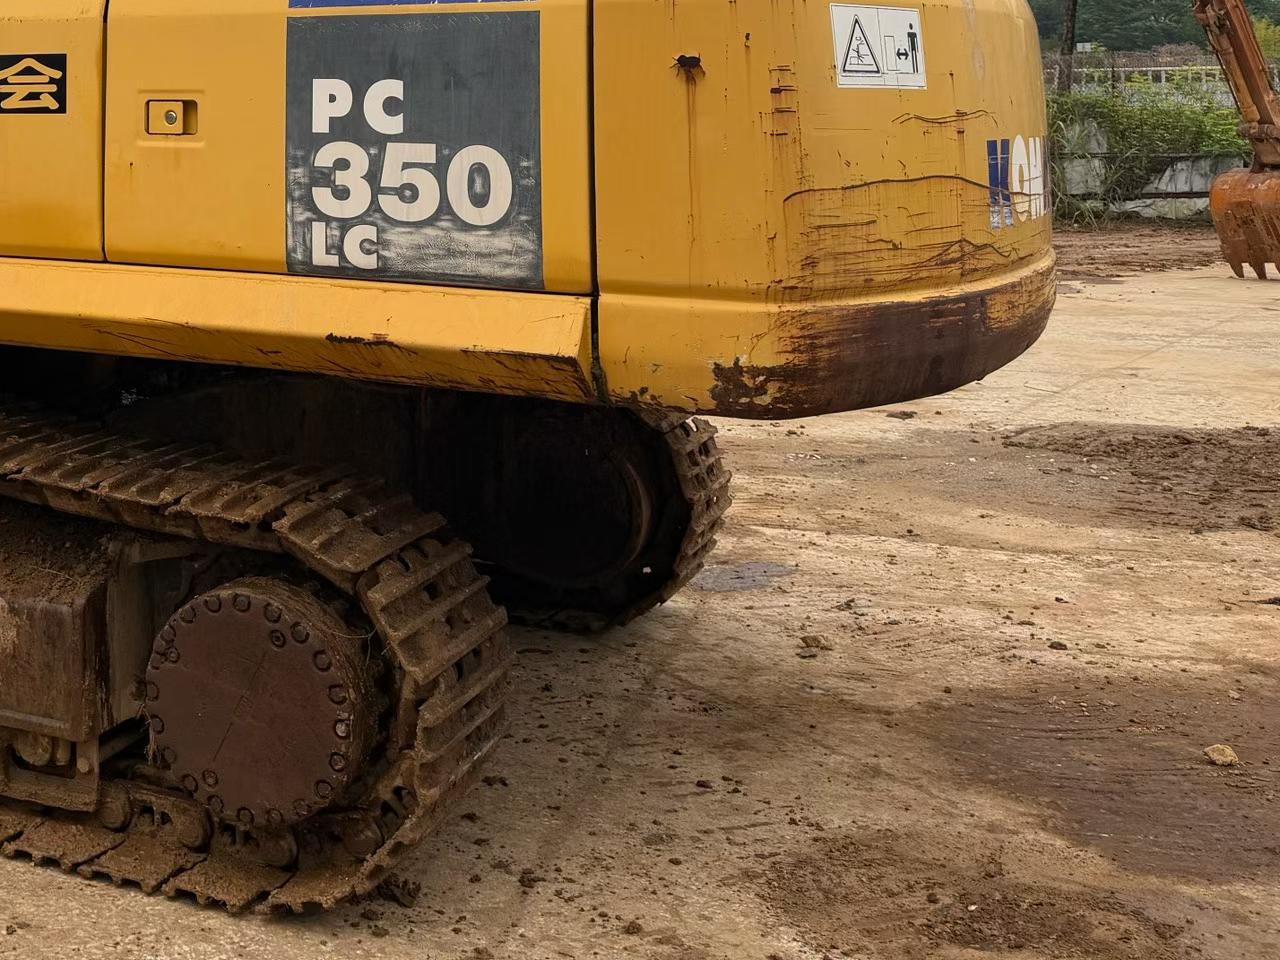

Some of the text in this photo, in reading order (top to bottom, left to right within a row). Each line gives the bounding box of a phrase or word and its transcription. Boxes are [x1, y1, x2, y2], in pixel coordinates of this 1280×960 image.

[312, 78, 404, 135] PC
[311, 140, 513, 226] 350
[311, 221, 378, 270] LC
